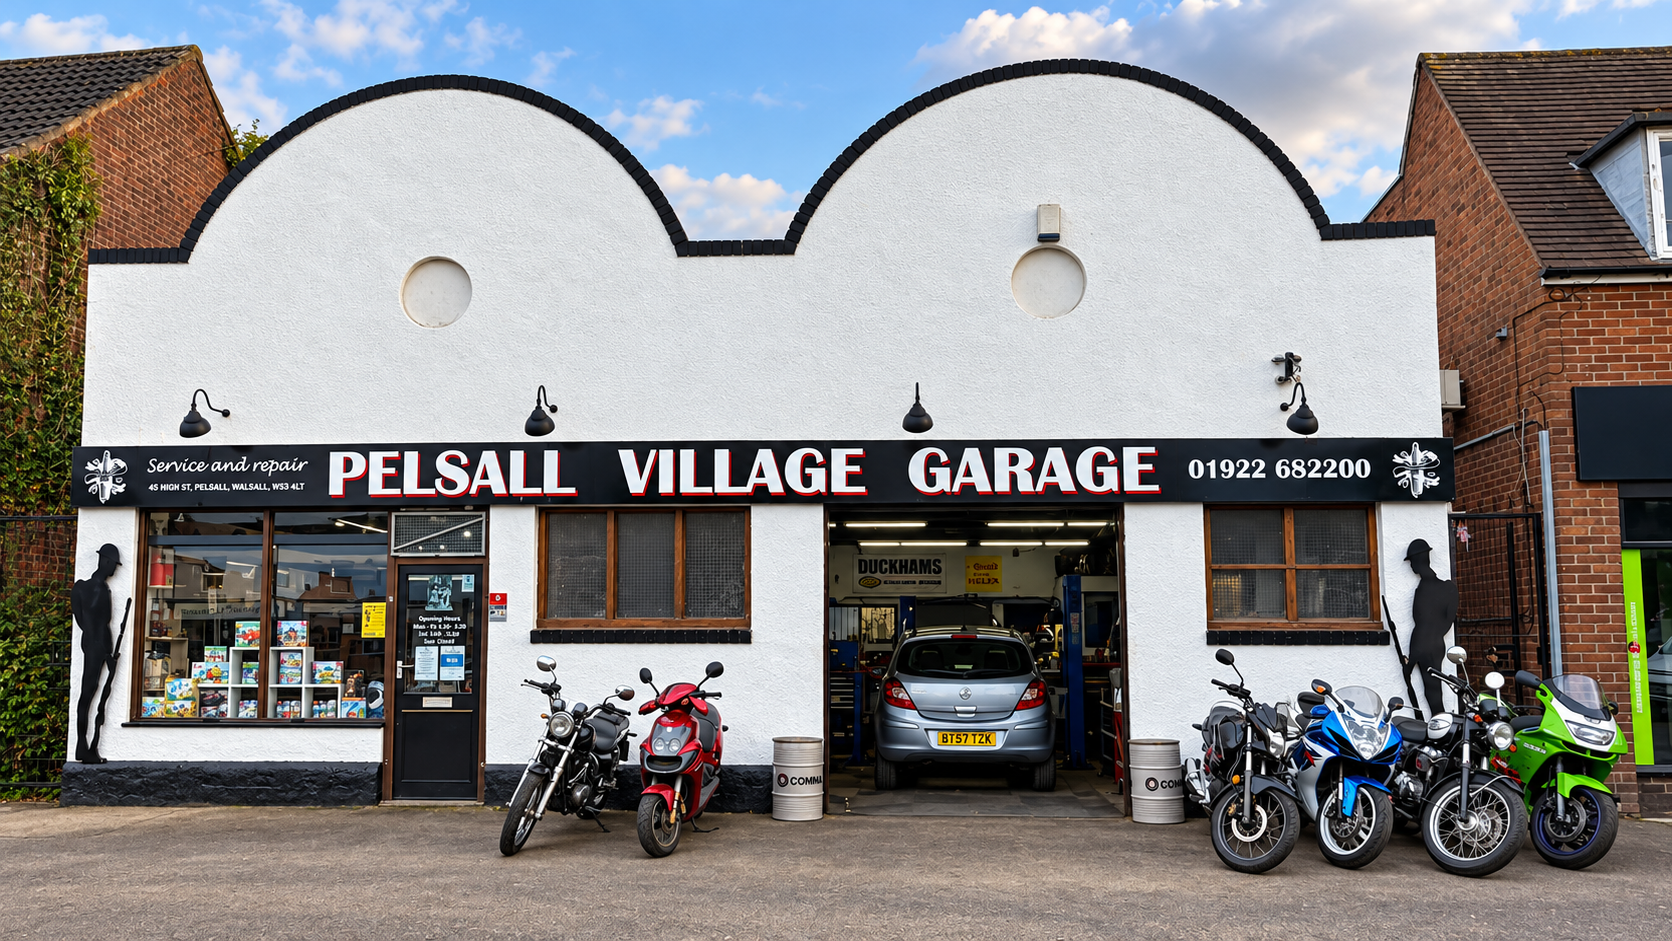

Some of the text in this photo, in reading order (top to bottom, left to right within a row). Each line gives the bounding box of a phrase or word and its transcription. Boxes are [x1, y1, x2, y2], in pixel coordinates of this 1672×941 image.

[147, 456, 308, 477] Service and repair
[328, 446, 1162, 498] PELSALL VILLAGE GARAGE
[1188, 458, 1371, 479] 01922 682200
[181, 484, 193, 492] ST,
[194, 483, 230, 492] PELSALL,
[231, 483, 271, 492] WALSALL,
[858, 559, 942, 574] DUCKHAMS
[941, 732, 993, 744] BT57 TZK
